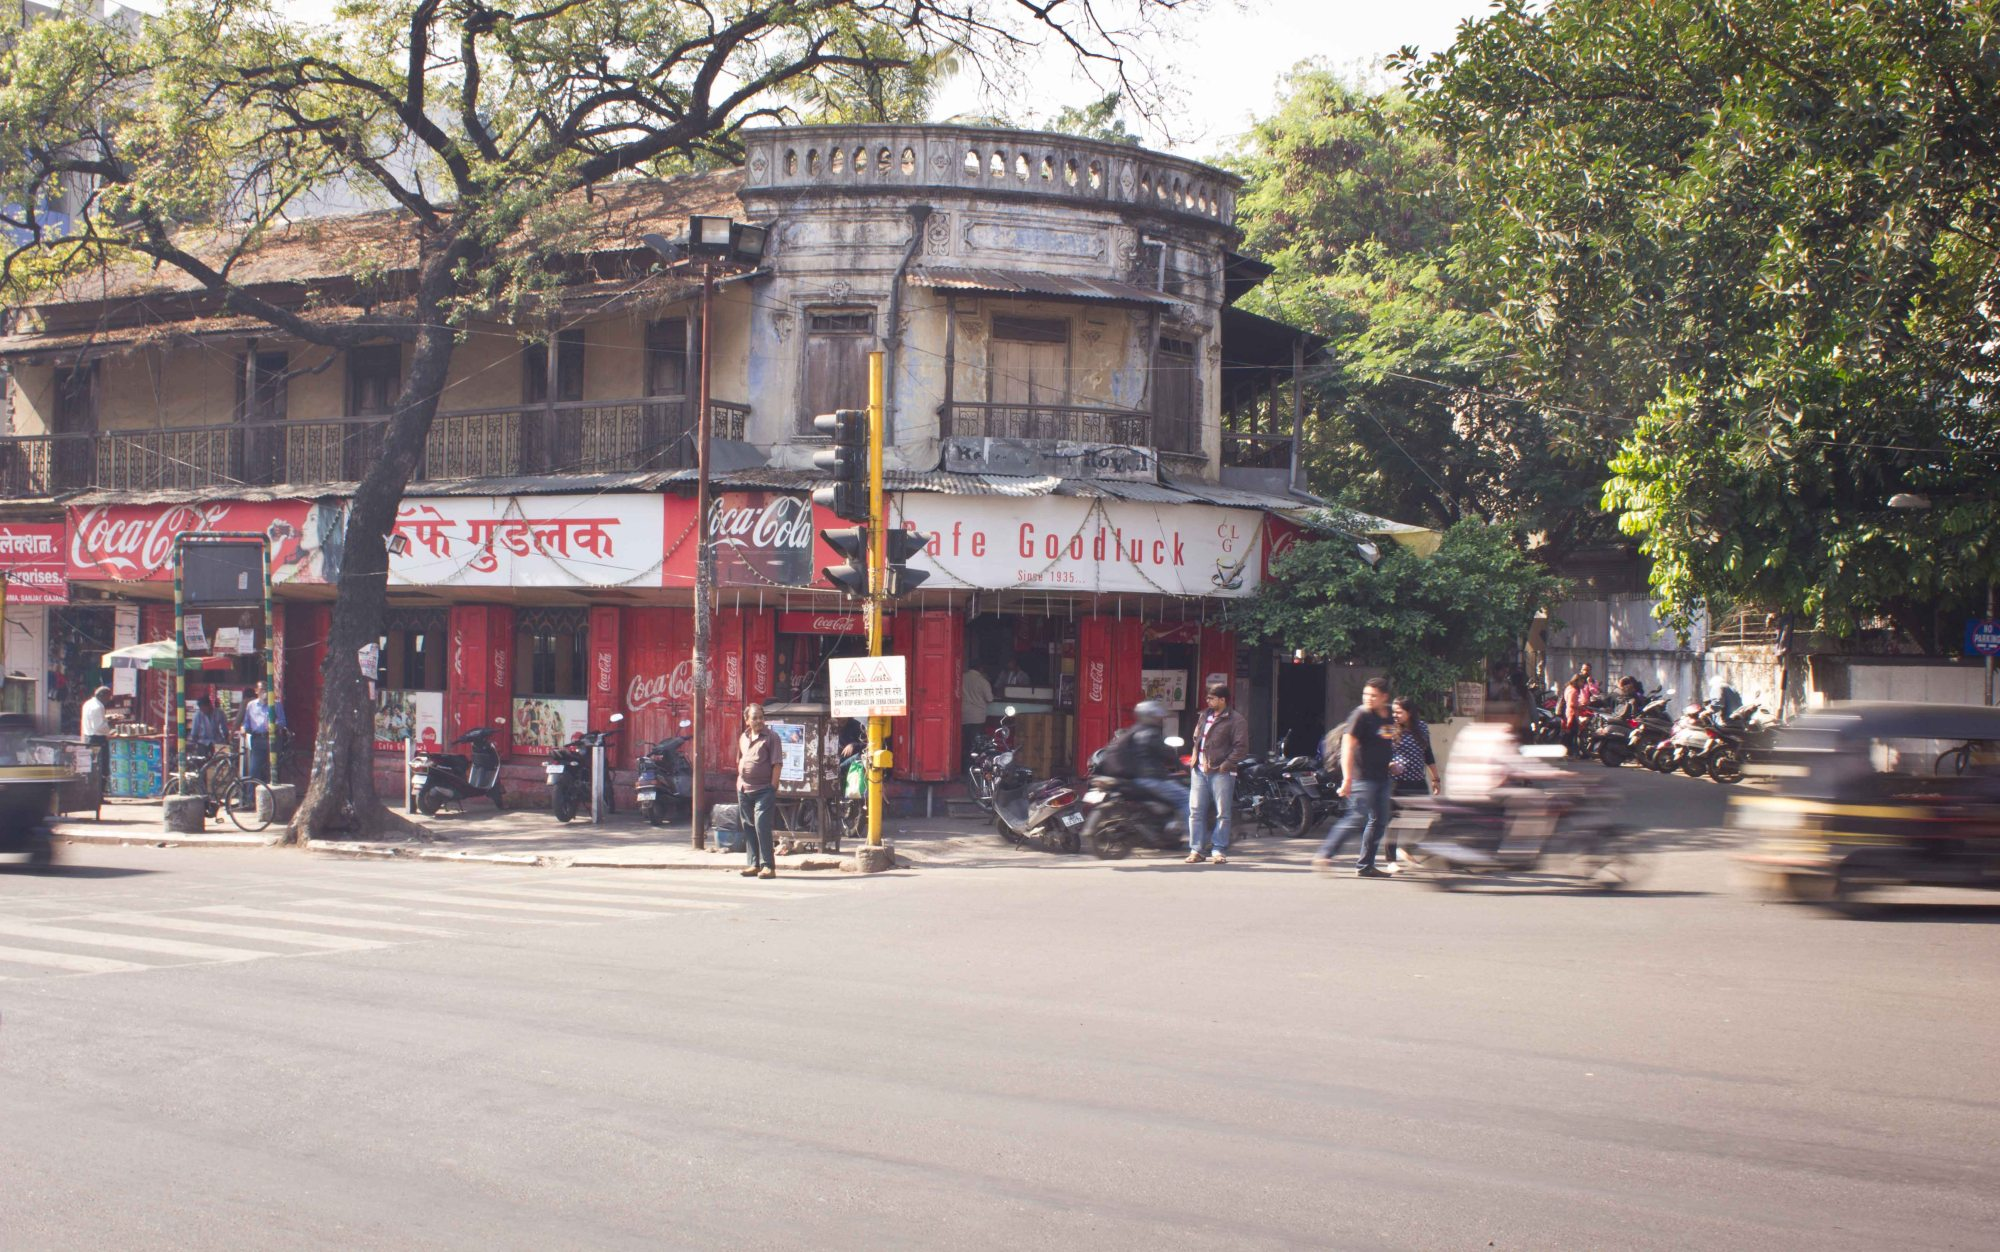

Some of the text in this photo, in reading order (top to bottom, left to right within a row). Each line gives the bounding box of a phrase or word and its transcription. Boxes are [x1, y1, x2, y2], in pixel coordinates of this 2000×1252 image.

[466, 517, 622, 573] गुडलक
[1019, 521, 1185, 567] Goodluck
[1983, 624, 1993, 634] NO
[1088, 660, 1104, 702] Coca-Cola
